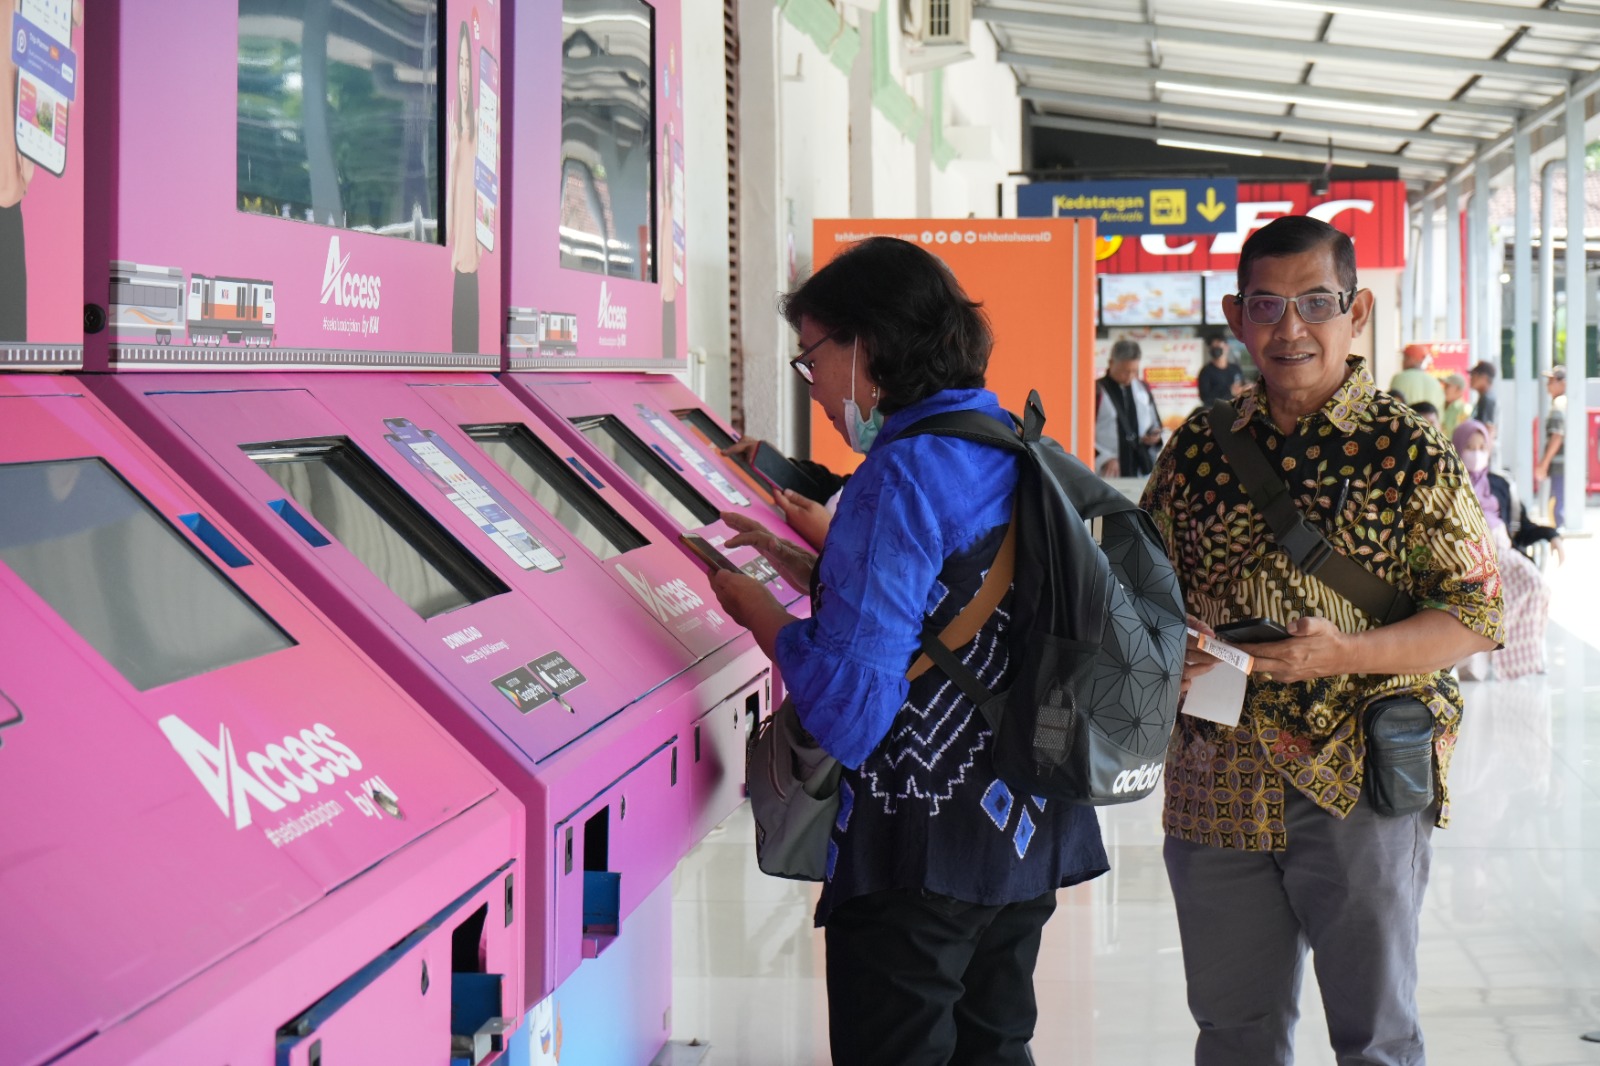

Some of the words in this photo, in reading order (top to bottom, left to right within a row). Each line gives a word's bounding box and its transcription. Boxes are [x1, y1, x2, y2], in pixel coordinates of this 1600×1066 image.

[1055, 194, 1144, 211] Kedatangan
[1100, 210, 1144, 223] Arrivals
[320, 235, 382, 310] Access
[597, 280, 627, 330] Access
[361, 314, 370, 338] by
[614, 562, 704, 623] Access
[442, 626, 483, 650] DOWNLOAD
[551, 671, 570, 687] App
[561, 667, 580, 681] Store
[515, 684, 538, 702] Google
[529, 682, 548, 696] Play
[157, 713, 363, 831] Access
[345, 790, 383, 820] by
